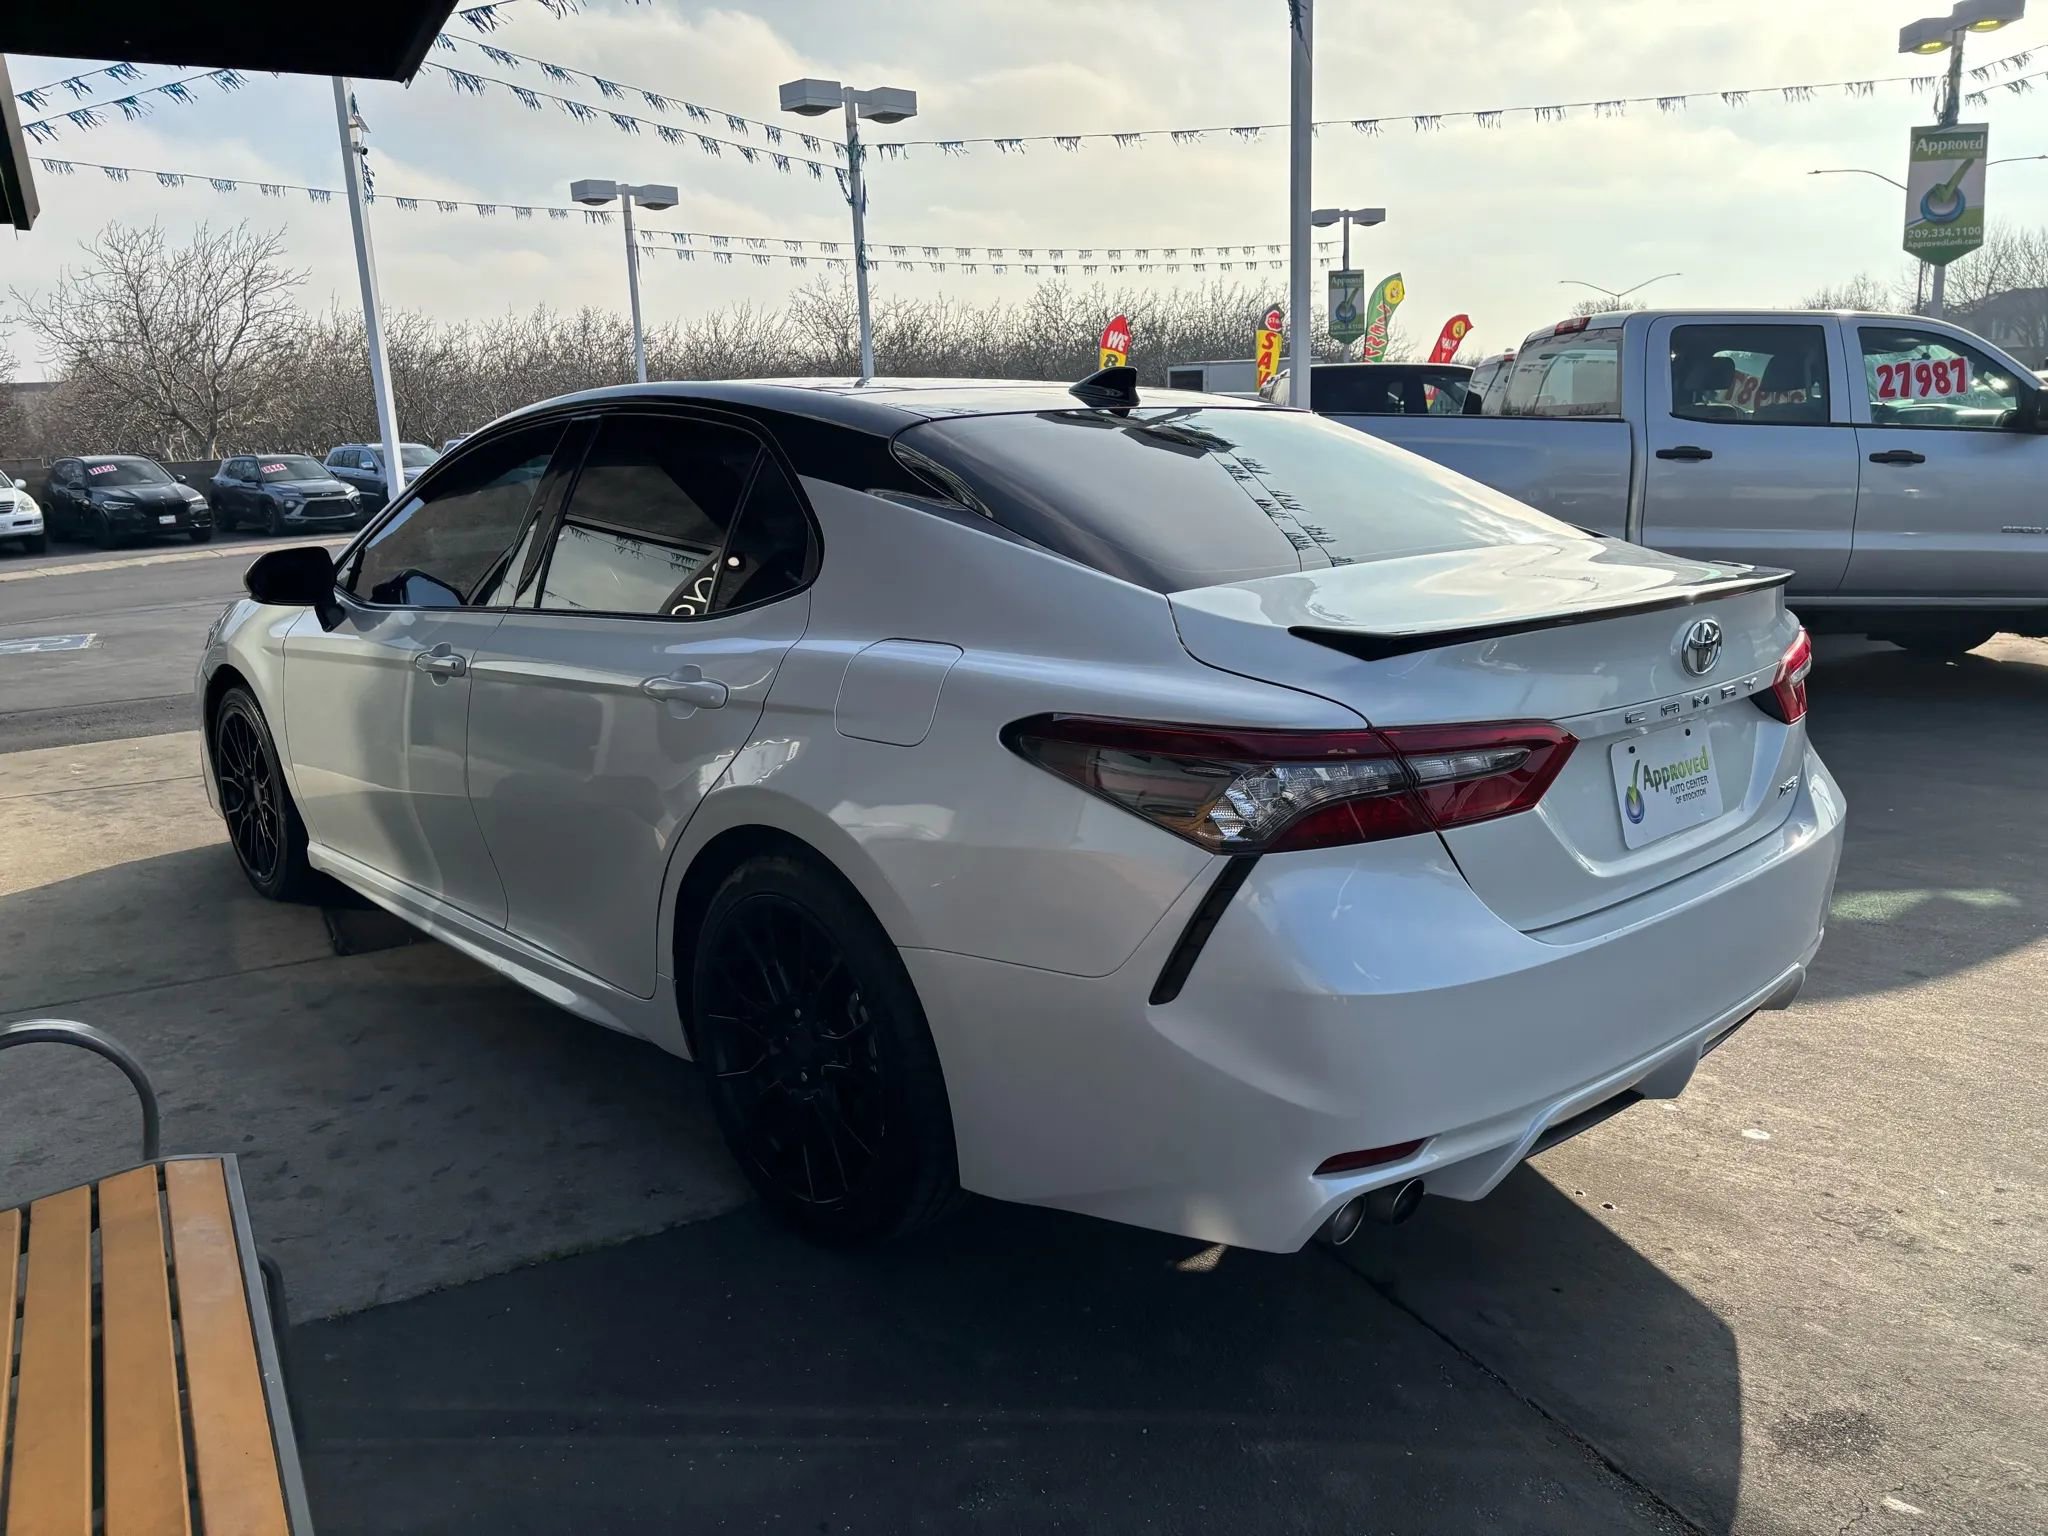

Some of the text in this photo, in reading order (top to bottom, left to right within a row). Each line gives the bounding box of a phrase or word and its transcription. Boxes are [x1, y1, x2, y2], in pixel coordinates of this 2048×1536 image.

[1106, 330, 1129, 352] WE
[1876, 357, 1967, 399] 27987
[1624, 676, 1758, 724] CAMRY
[1670, 775, 1709, 796] AUTO CENTER
[1675, 788, 1707, 805] OF STOCKTON
